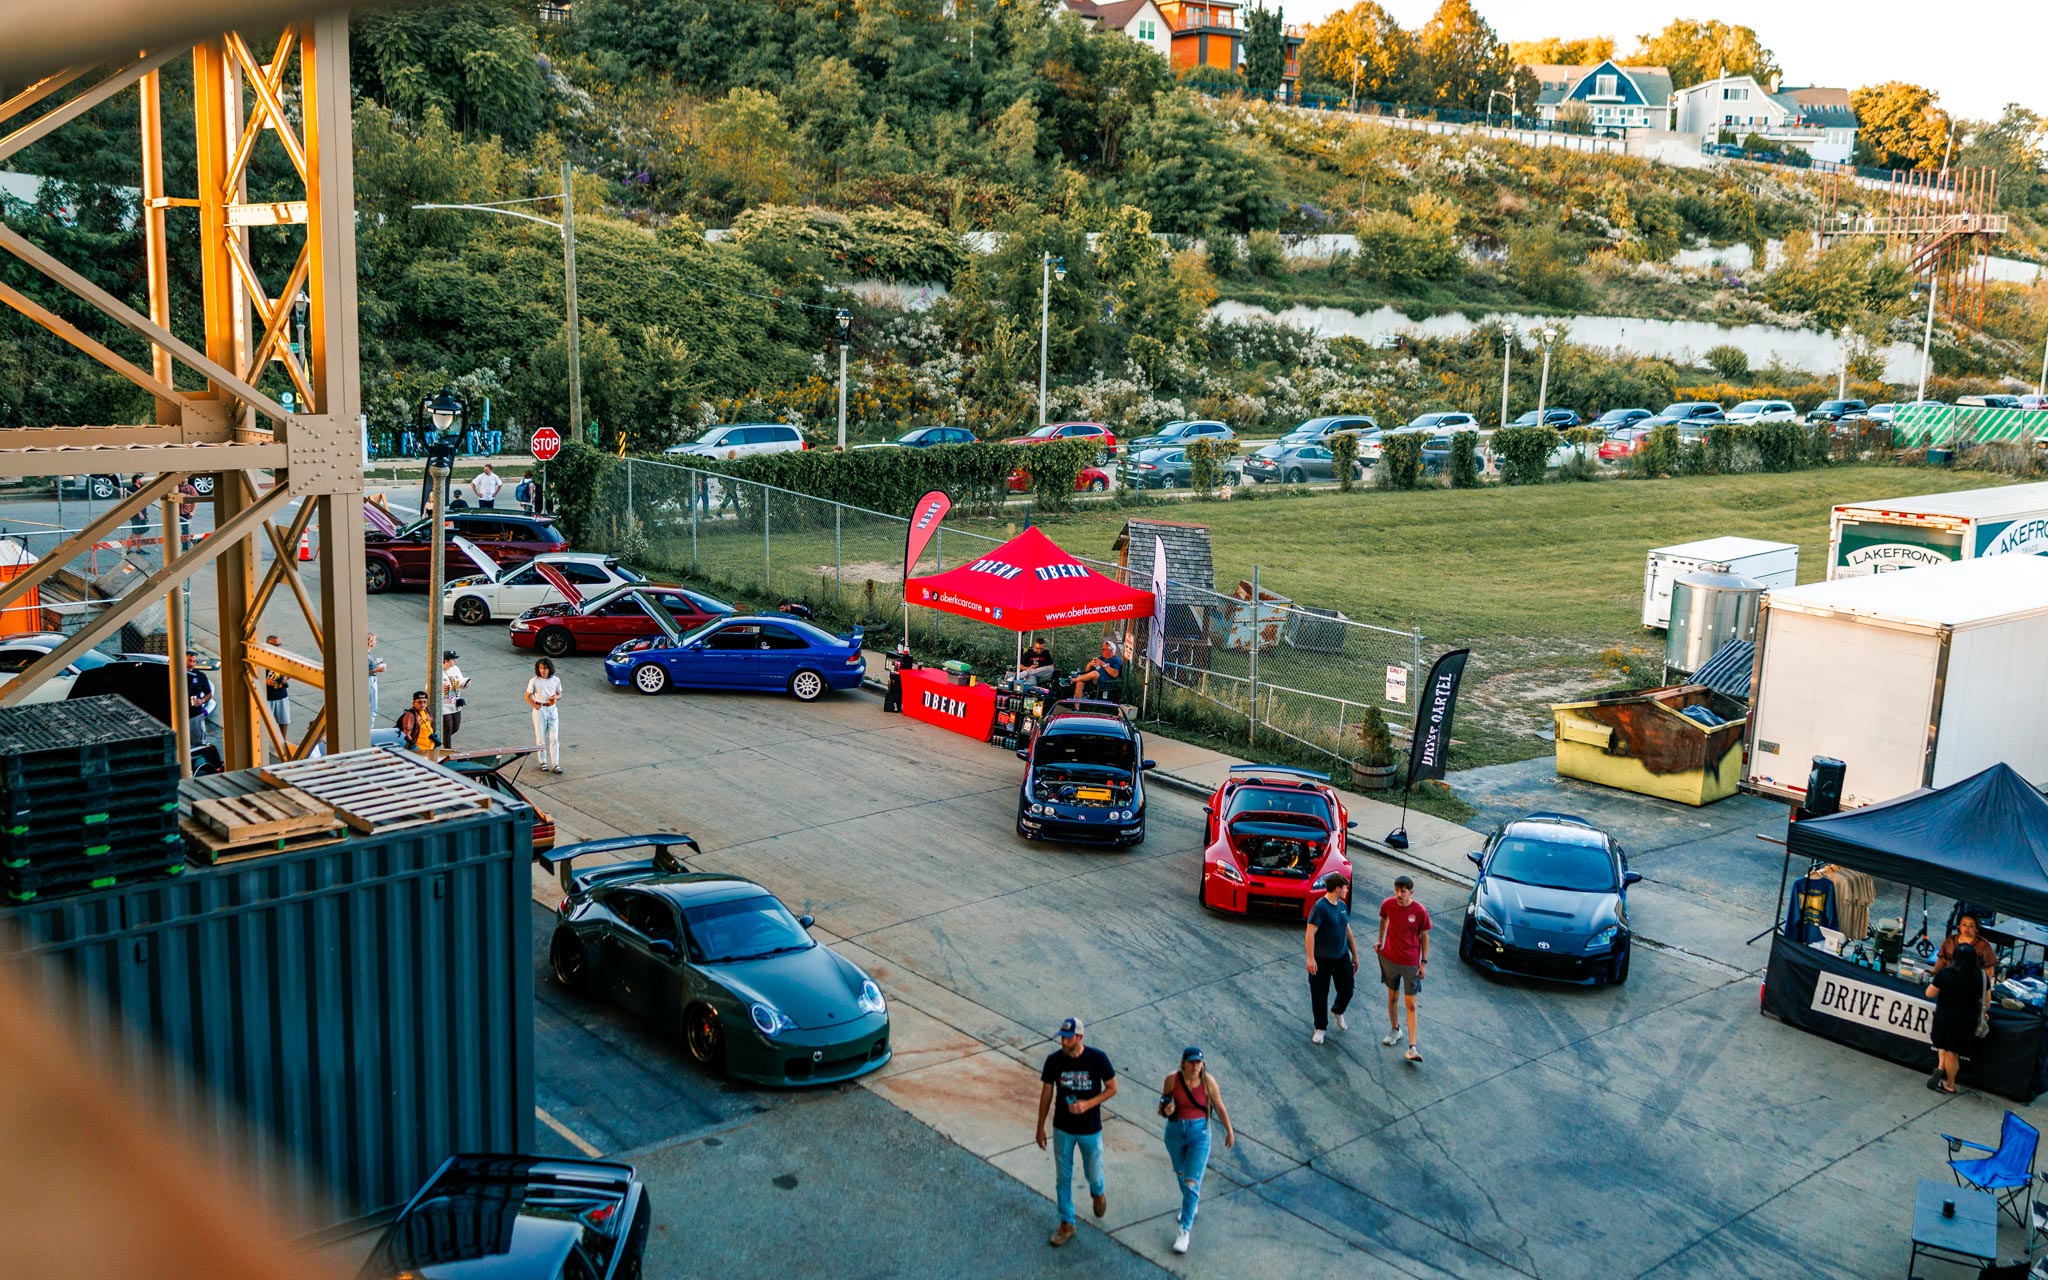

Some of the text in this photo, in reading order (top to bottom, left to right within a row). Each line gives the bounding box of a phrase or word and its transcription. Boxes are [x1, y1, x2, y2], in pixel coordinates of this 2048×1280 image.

[533, 438, 559, 451] STOP
[1853, 548, 1942, 565] LAKEFRONT
[969, 560, 1022, 580] OBERK
[1035, 564, 1090, 580] OBERK
[940, 592, 983, 612] oberkcarcare
[1045, 603, 1133, 621] www.oberkcarcare.com
[923, 690, 966, 719] OBERK
[1421, 726, 1438, 767] DRIVE
[1431, 673, 1453, 723] CARTEL
[1820, 981, 1936, 1034] DRIVE CAR
